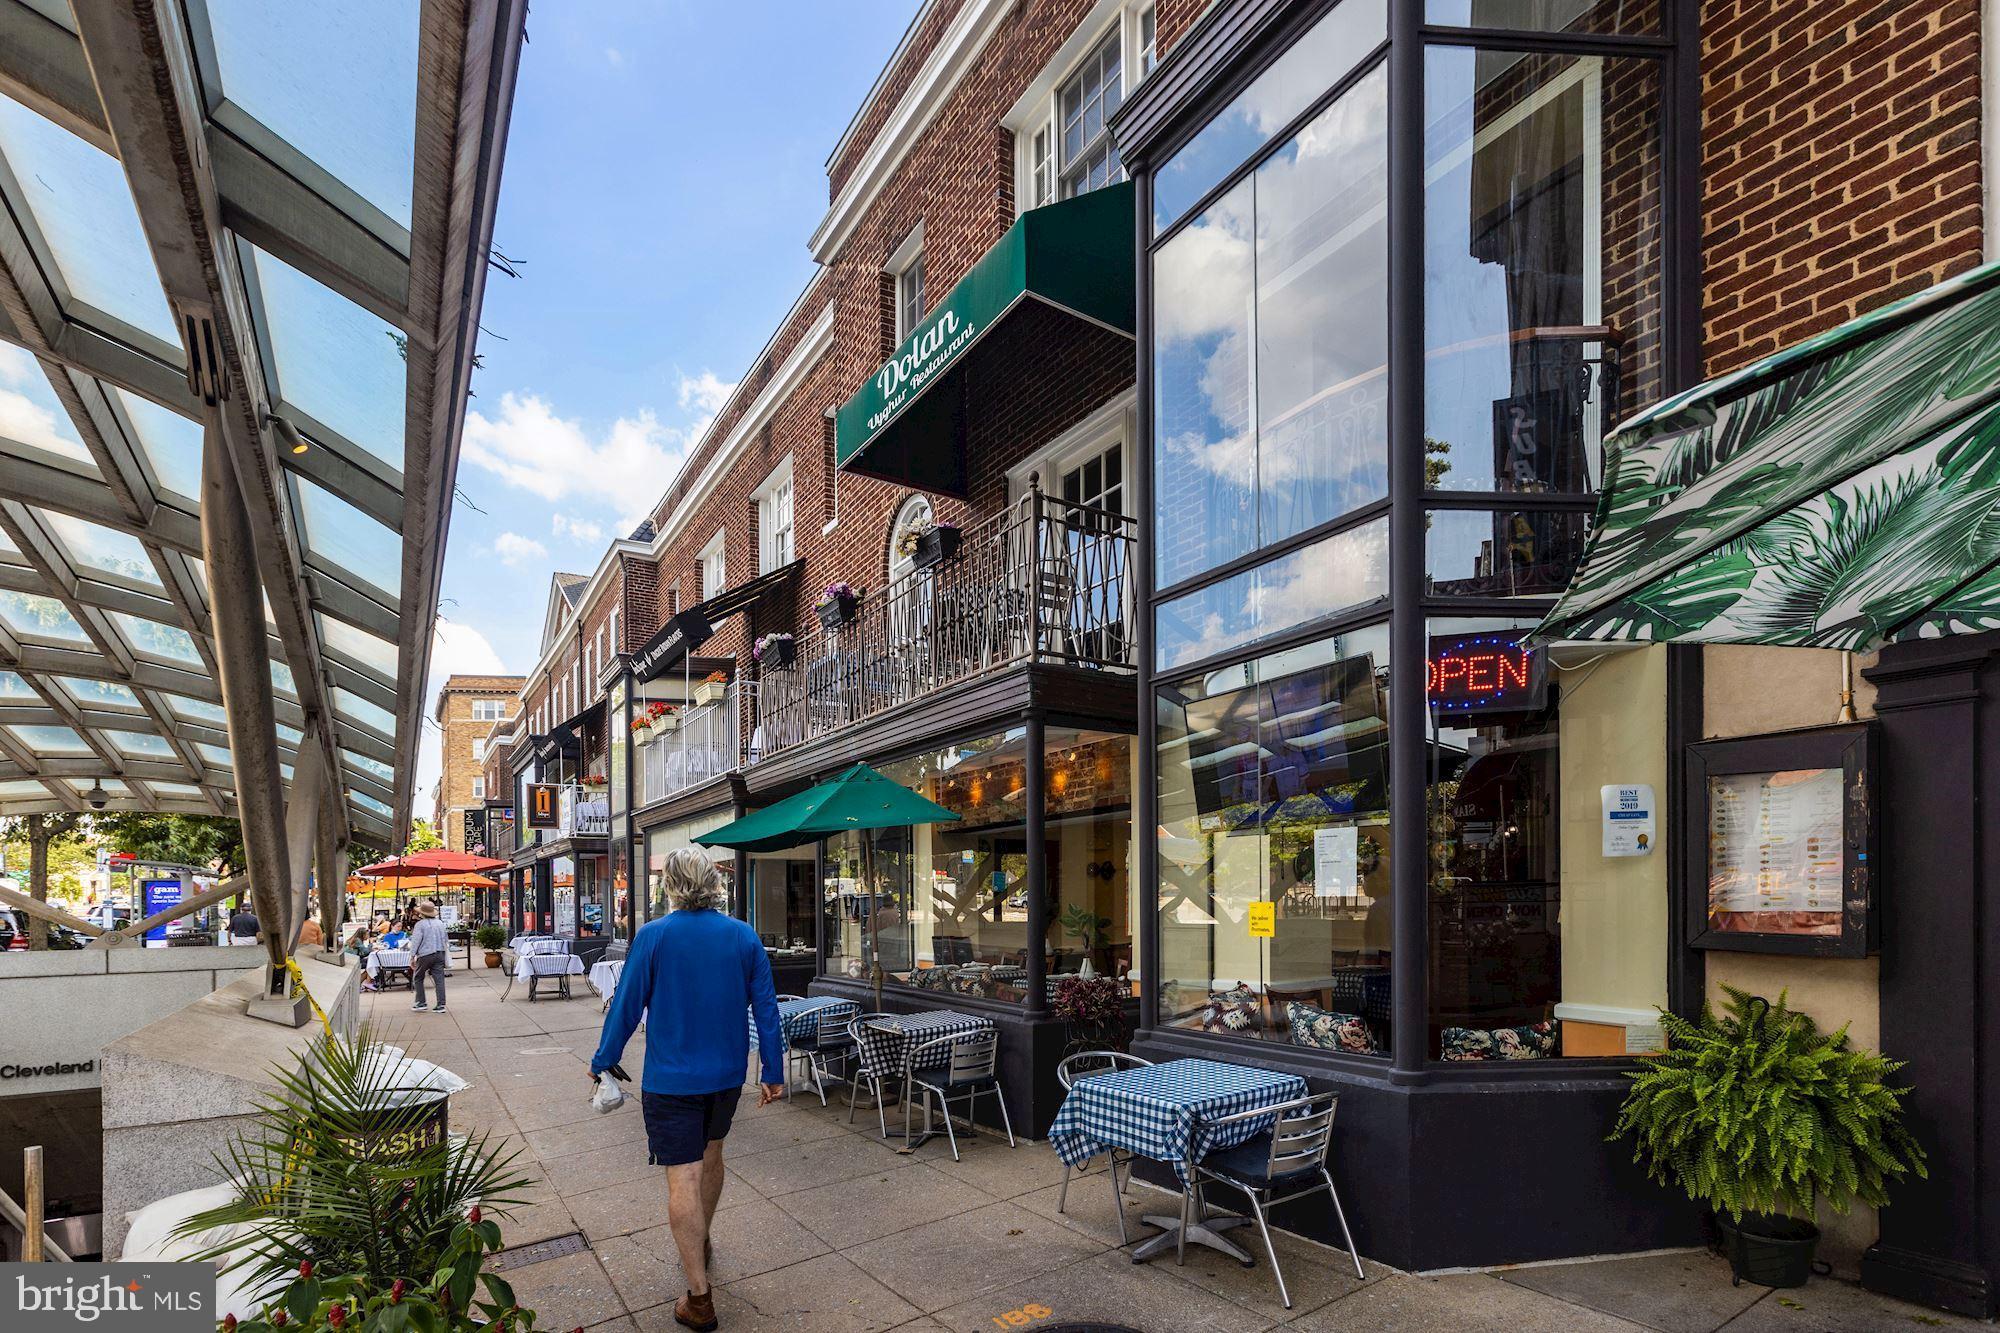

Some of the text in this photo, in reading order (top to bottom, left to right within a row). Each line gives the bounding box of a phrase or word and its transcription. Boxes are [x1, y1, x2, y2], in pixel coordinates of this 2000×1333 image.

[877, 310, 959, 400] Dolan
[867, 322, 975, 430] Uyghur Restaurant
[465, 812, 474, 850] MEDIUM
[154, 887, 179, 895] gam
[0, 1060, 94, 1079] Cleveland
